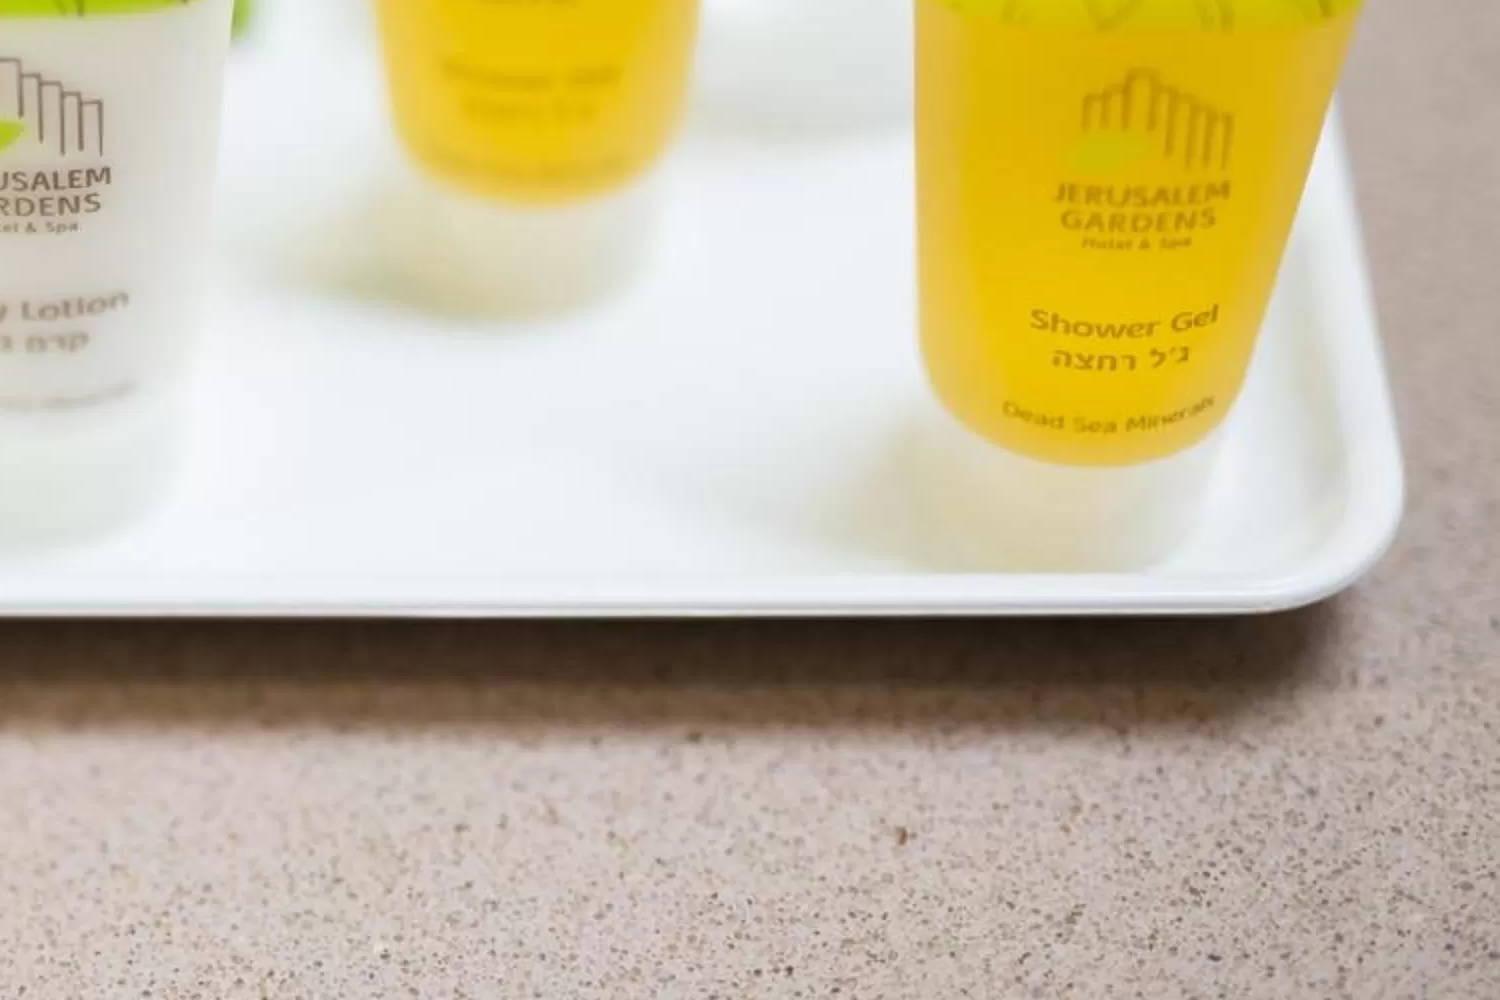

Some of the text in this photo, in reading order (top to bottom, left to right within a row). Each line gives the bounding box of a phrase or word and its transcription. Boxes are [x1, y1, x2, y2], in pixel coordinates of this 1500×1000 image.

[1055, 180, 1232, 207] JERUSALEM
[25, 220, 37, 234] &
[45, 220, 81, 235] Spa
[1060, 207, 1216, 235] GARDENS
[20, 291, 131, 322] Lotion
[1029, 303, 1220, 340] Shower Gel
[1051, 348, 1137, 371] רחצה
[1002, 399, 1065, 430] Dead
[1074, 414, 1119, 434] Sea
